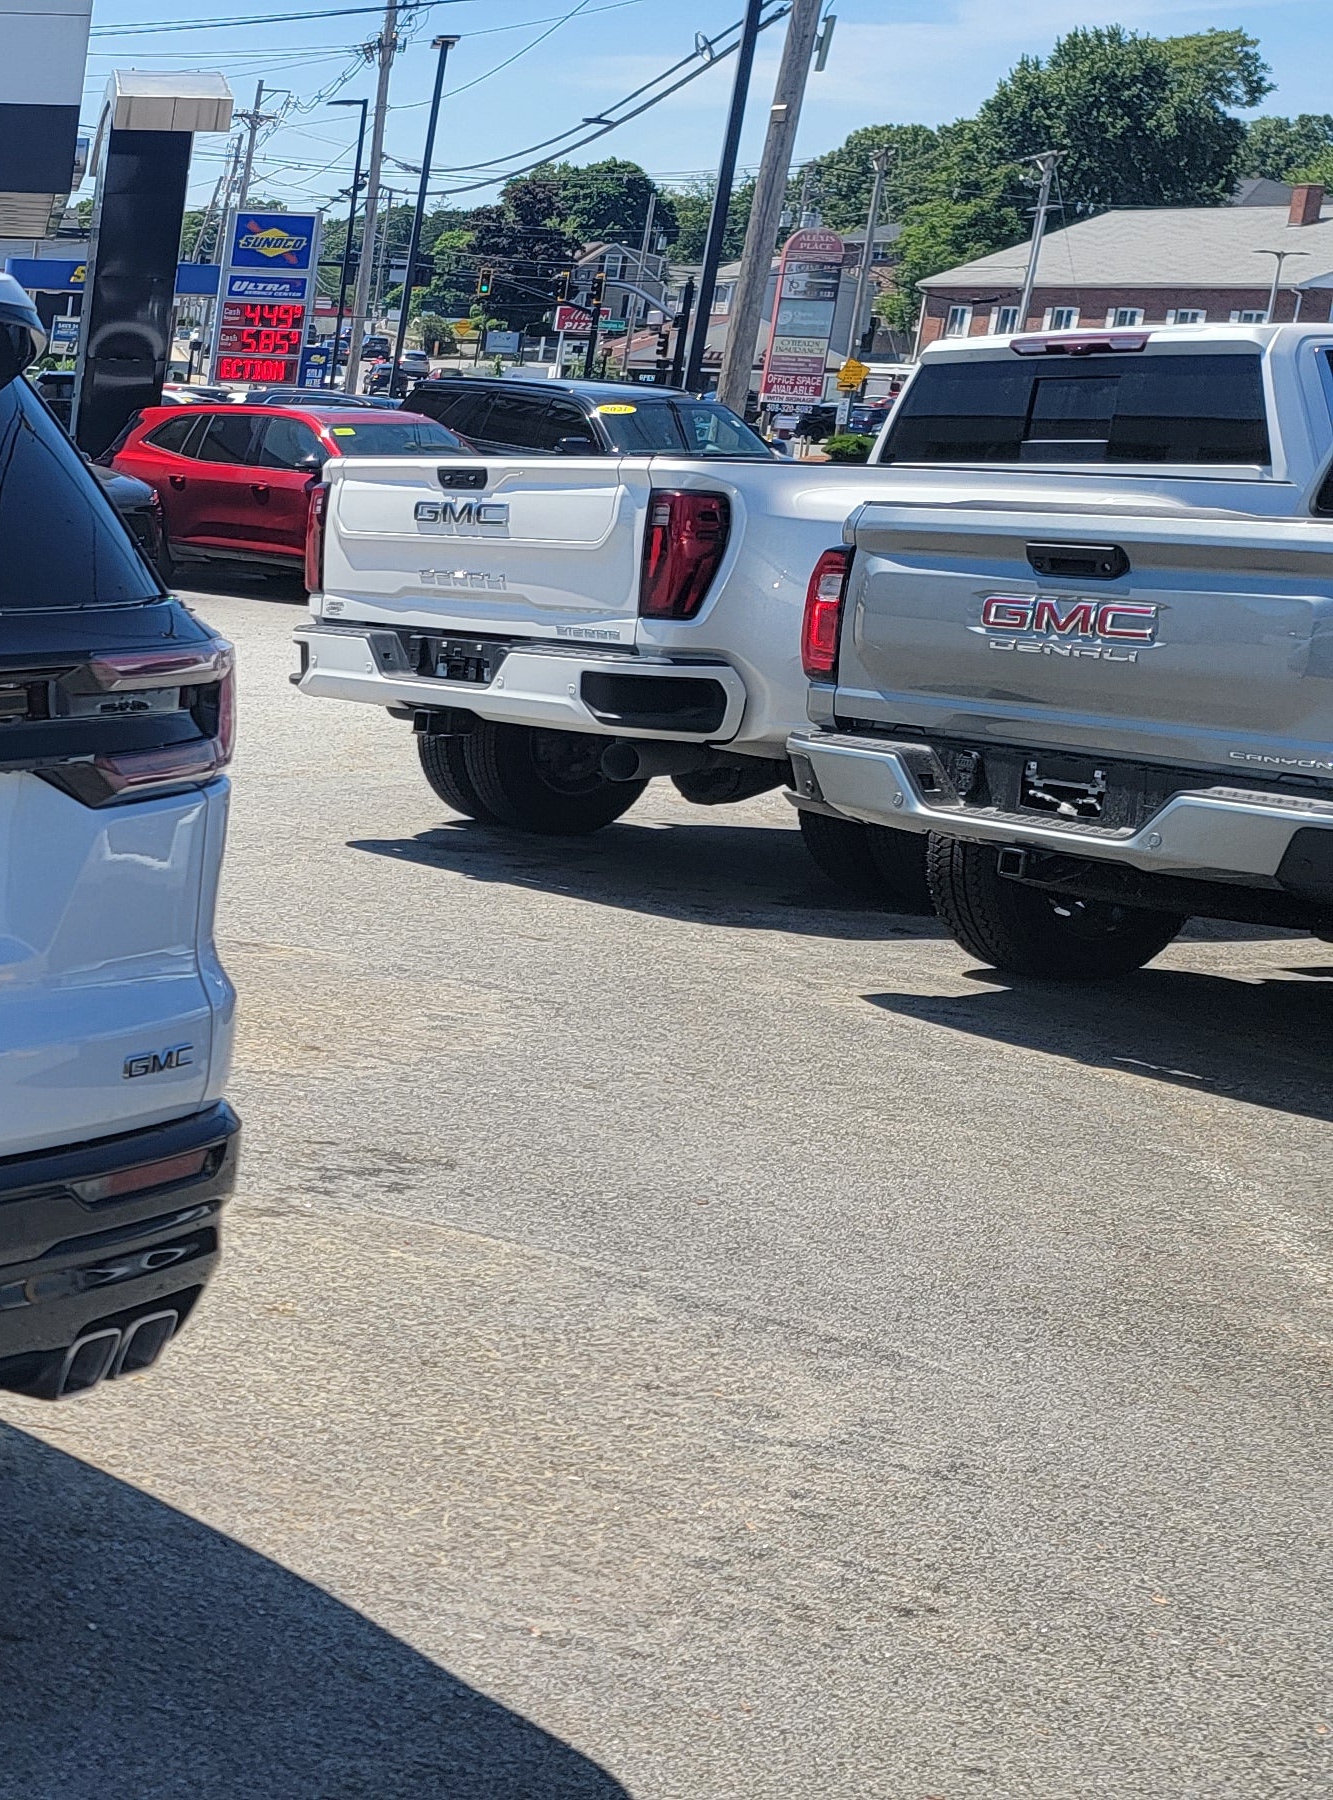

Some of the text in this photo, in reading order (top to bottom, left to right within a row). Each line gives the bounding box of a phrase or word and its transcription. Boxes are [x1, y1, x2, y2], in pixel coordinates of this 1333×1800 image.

[241, 236, 305, 249] SUNOCO
[799, 233, 836, 242] ALEXIS
[799, 242, 833, 250] PLACE
[232, 281, 290, 292] ULTRA
[224, 307, 241, 316] Cash
[220, 333, 238, 342] Cash
[767, 373, 823, 386] OFFICE SPACE
[770, 384, 815, 395] AVAILABLE
[414, 500, 510, 525] GMC
[981, 596, 1159, 641] GMC
[988, 638, 1139, 663] DENALI
[1229, 751, 1333, 771] CANYON
[122, 1042, 195, 1079] GMC
